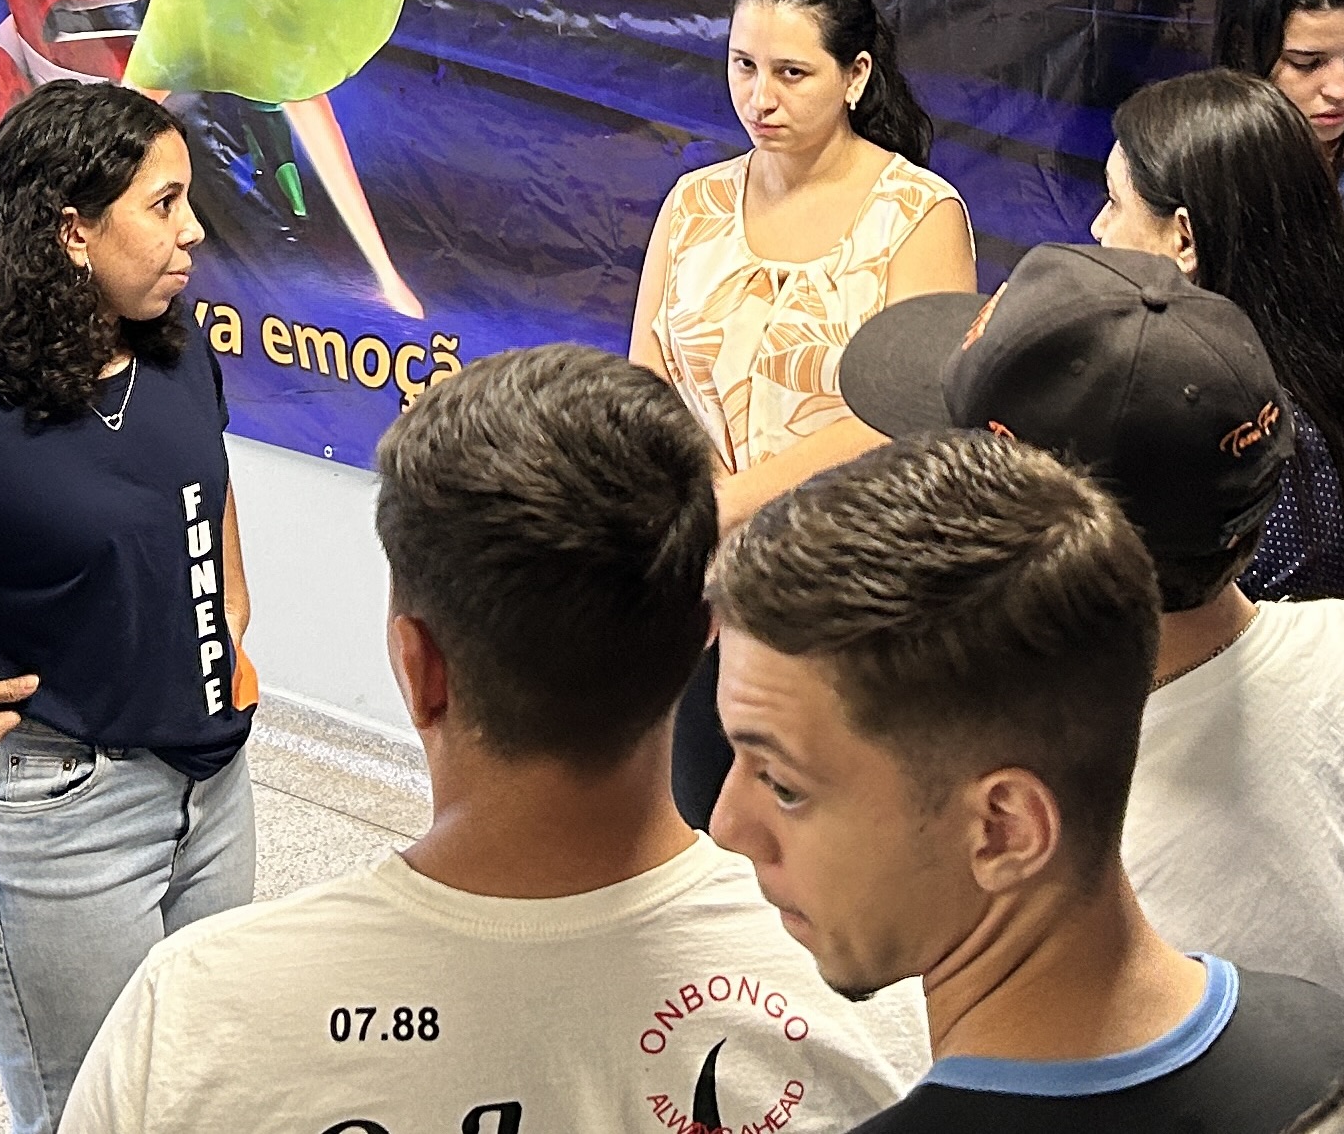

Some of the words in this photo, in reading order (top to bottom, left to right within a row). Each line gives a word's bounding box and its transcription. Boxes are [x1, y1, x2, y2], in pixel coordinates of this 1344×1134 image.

[181, 482, 225, 717] FUNEPE
[330, 1006, 440, 1042] 07.88
[640, 975, 809, 1055] ONBONGO
[741, 1079, 805, 1134] AHEAD
